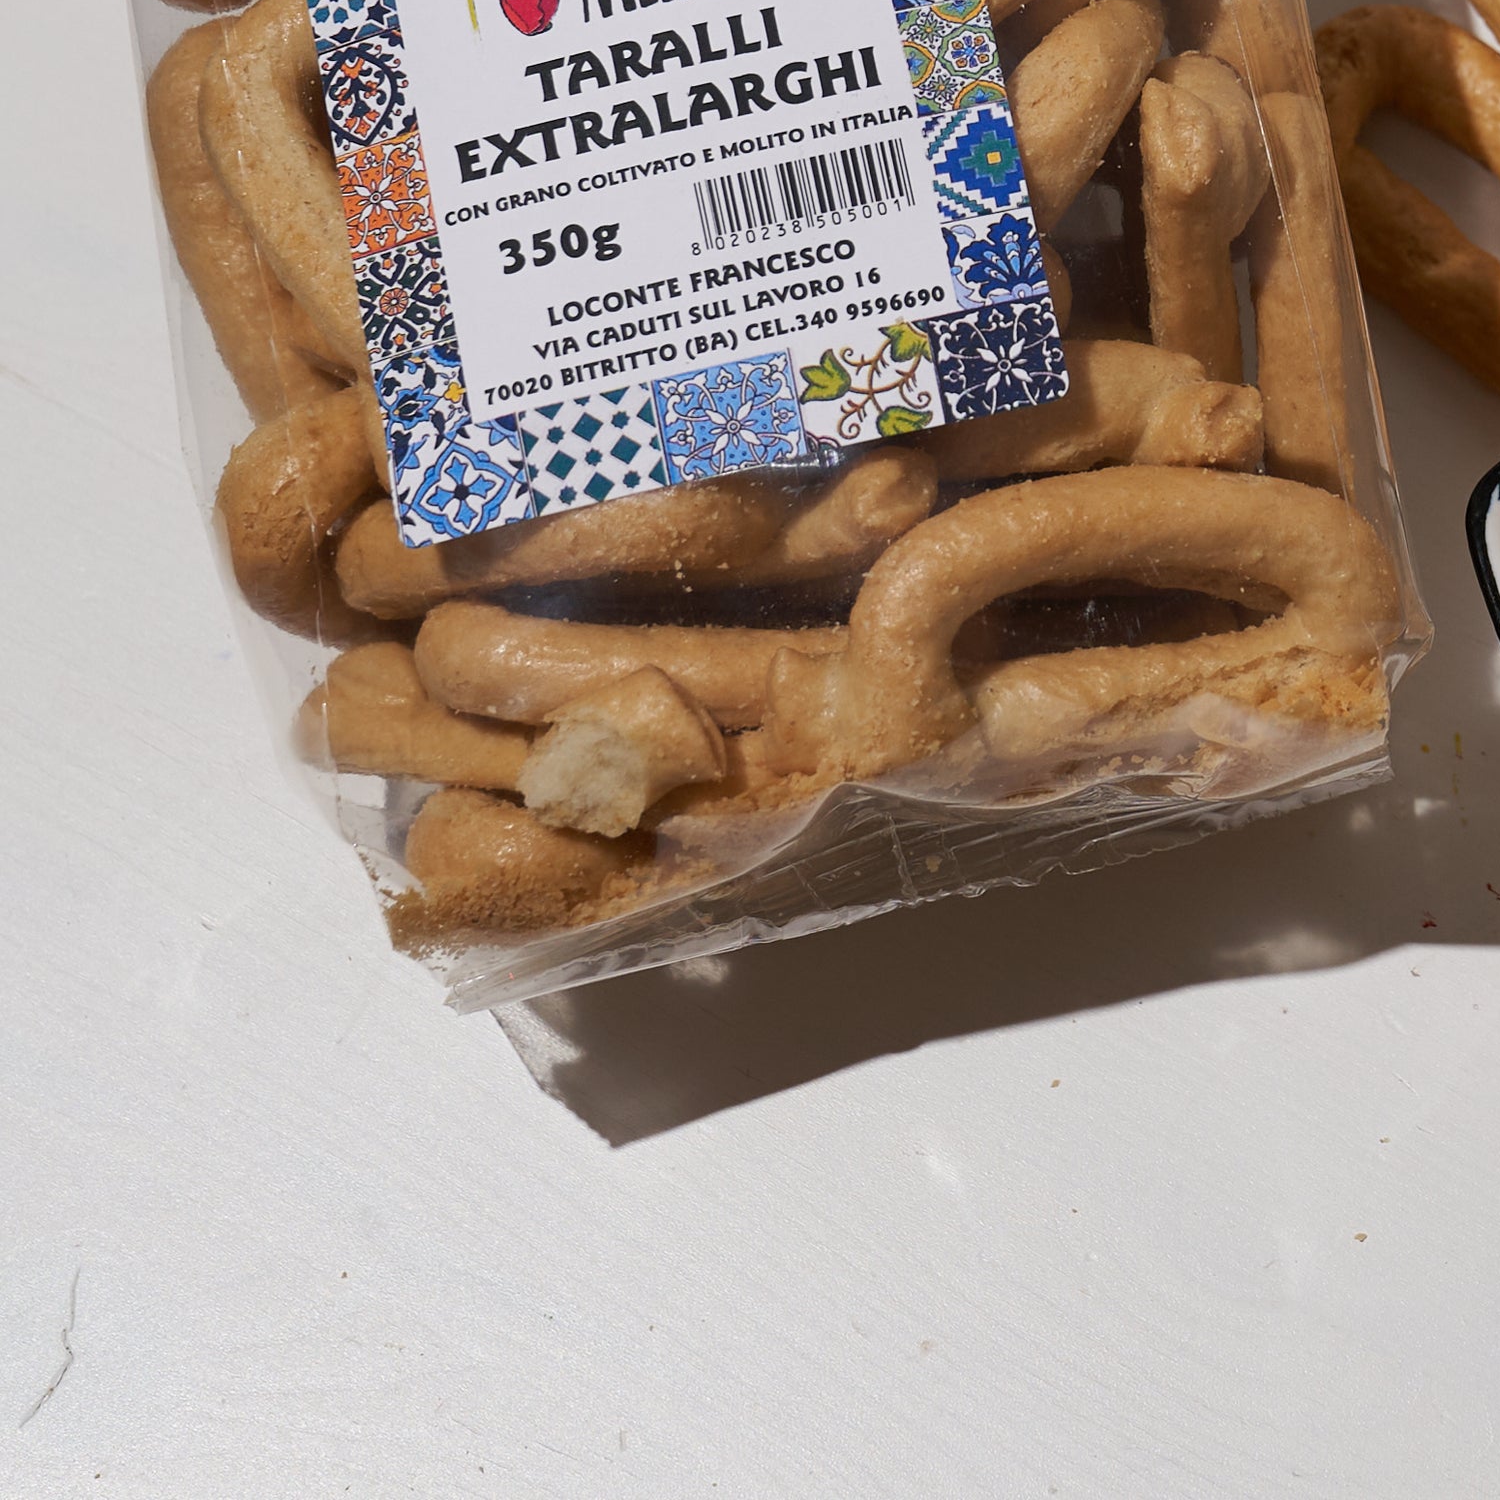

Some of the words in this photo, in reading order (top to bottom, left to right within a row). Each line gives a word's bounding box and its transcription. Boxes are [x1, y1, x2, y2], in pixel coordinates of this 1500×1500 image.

[524, 6, 783, 103] TARALLI
[454, 46, 882, 184] EXTRALARGHI
[444, 201, 490, 227] CON
[495, 181, 572, 212] GRANO
[577, 152, 696, 193] COLTIVATO
[702, 148, 715, 163] E
[719, 128, 805, 160] MOLITO
[810, 120, 836, 139] IN
[841, 105, 913, 133] ITALIA
[498, 222, 622, 275] 350g
[547, 277, 682, 327] LOCONTE
[689, 239, 856, 293] FRANCESCO
[484, 374, 553, 406] 70020
[560, 343, 678, 387] BITRITTO
[685, 328, 738, 361] (BA)
[846, 285, 945, 321] 9596690
[532, 336, 580, 360] VIA
[586, 310, 682, 348] CADUTI
[688, 299, 737, 325] SUL
[742, 275, 845, 313] LAVORO
[855, 267, 881, 288] 16
